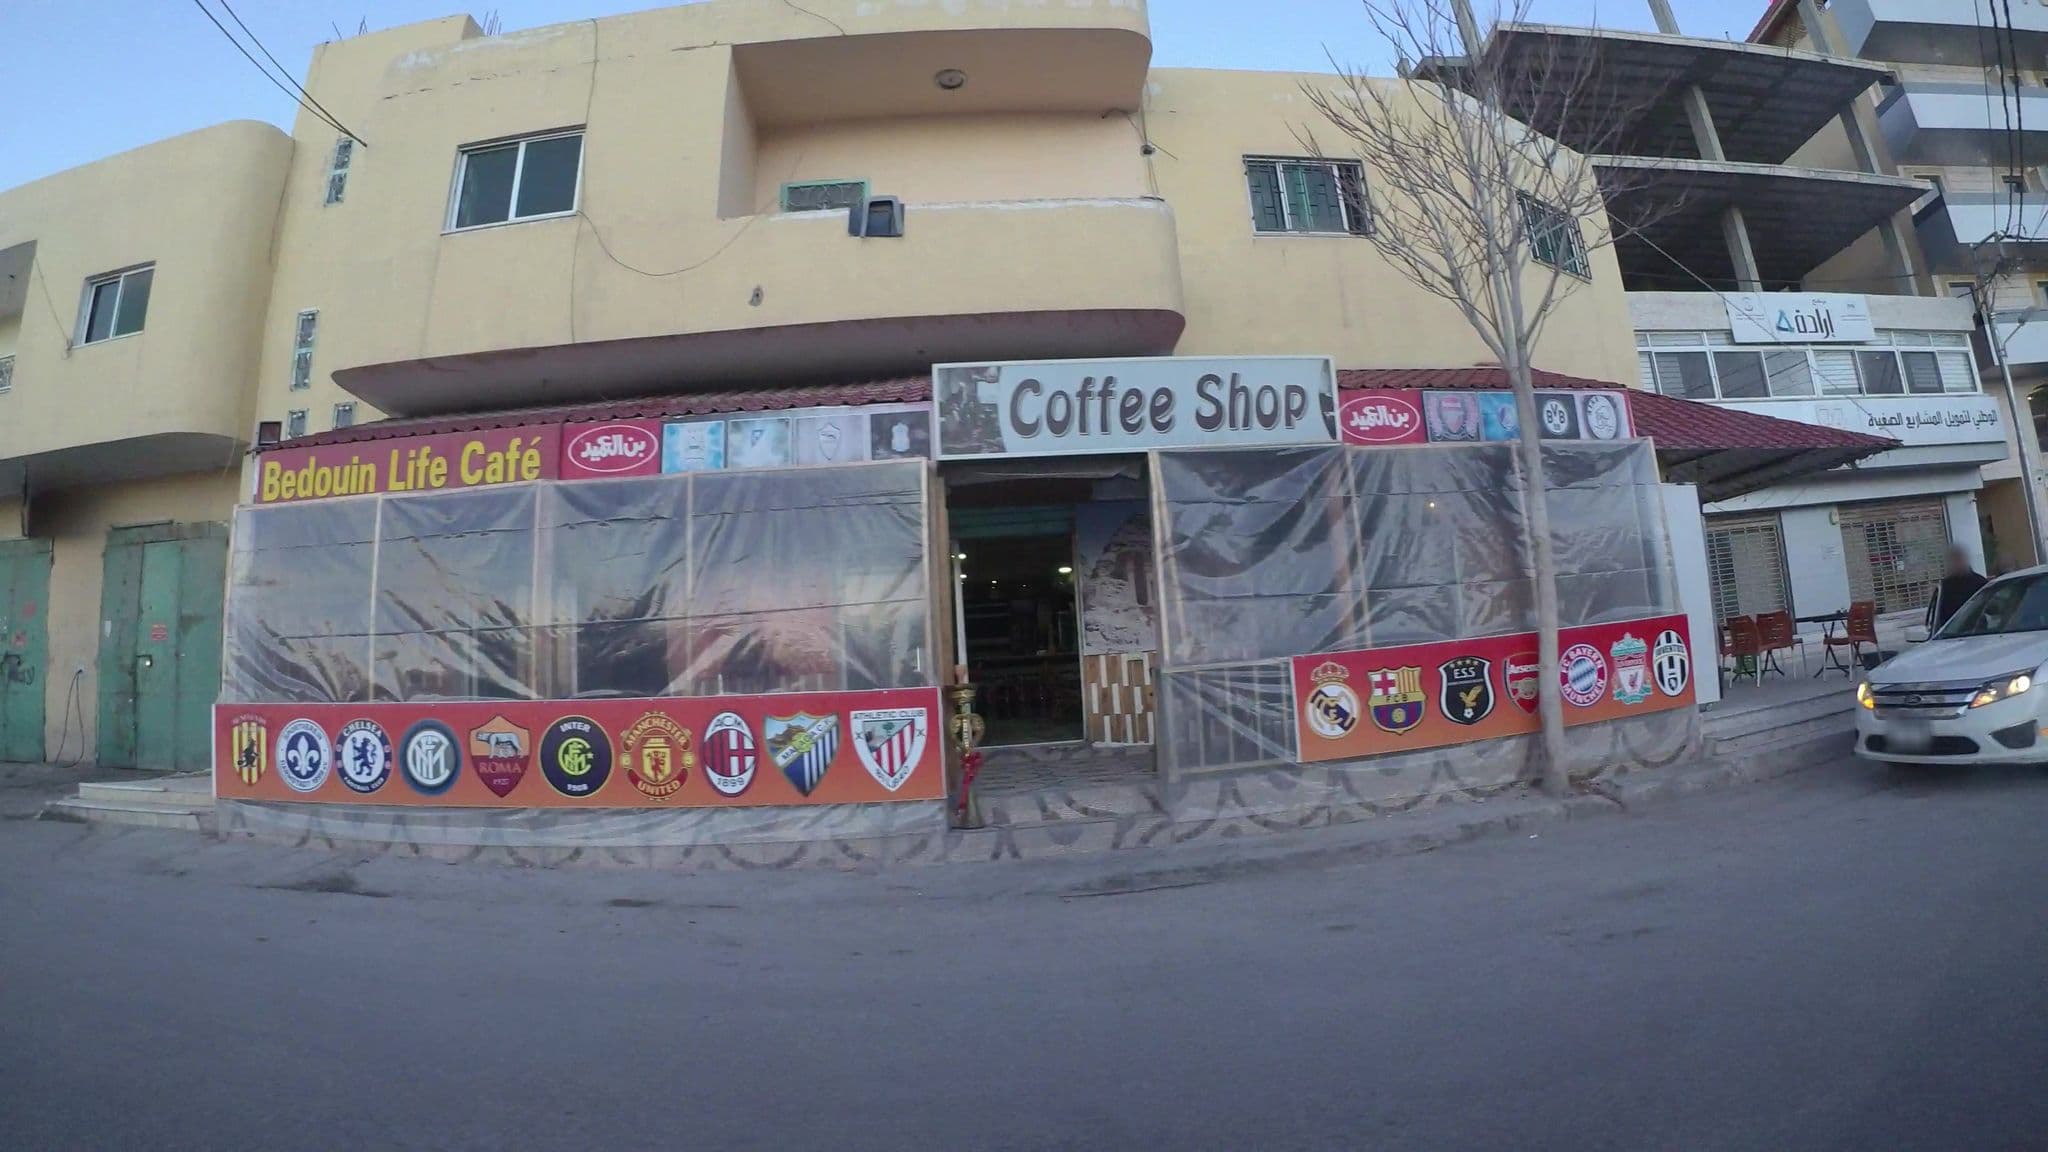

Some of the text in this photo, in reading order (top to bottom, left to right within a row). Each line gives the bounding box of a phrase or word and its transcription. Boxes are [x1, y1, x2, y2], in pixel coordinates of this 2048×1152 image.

[1010, 372, 1309, 439] Coffee Shop
[263, 436, 542, 502] Bedouin Life Café
[1453, 667, 1476, 679] ESS
[342, 721, 383, 737] CHELSEA
[560, 721, 591, 732] INTER
[625, 717, 688, 747] MANCHESTER
[480, 762, 521, 774] ROMA
[637, 780, 680, 796] UNITED
